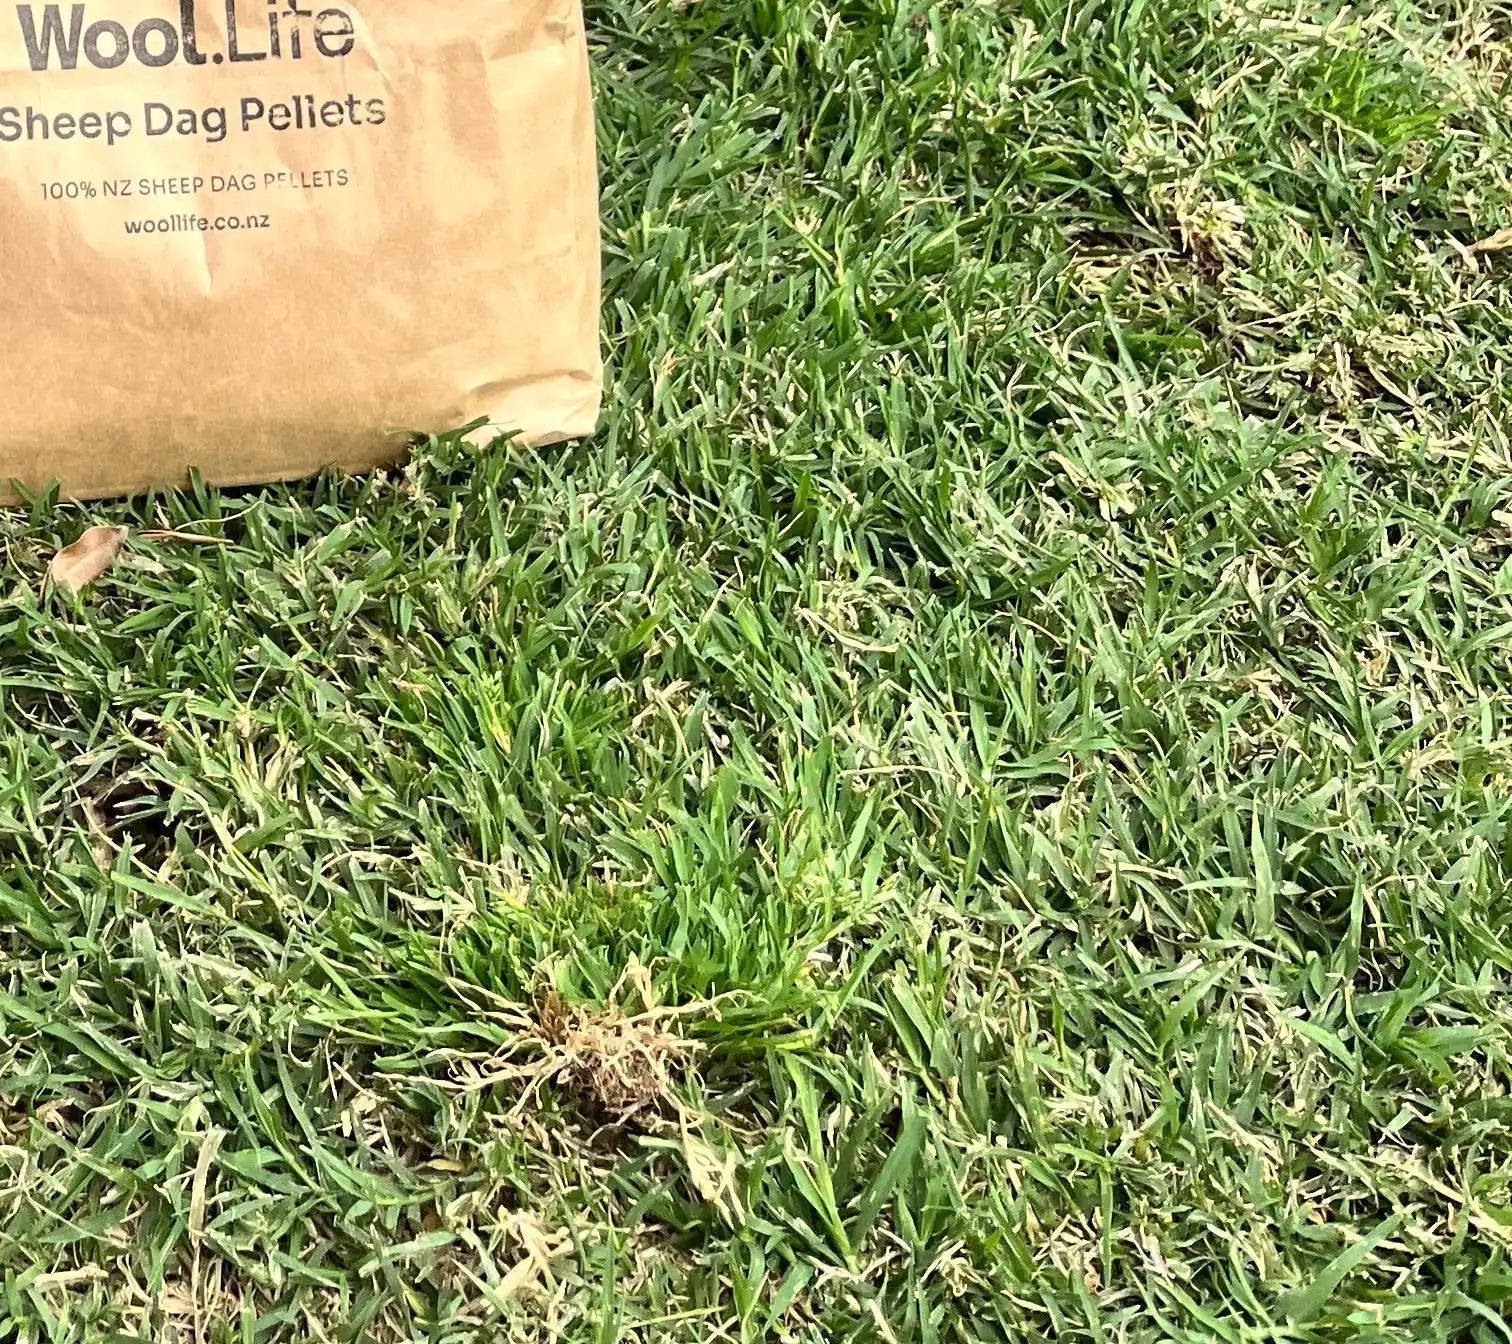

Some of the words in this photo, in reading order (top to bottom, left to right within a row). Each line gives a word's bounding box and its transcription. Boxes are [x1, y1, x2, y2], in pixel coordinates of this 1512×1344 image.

[143, 99, 228, 143] Dag
[240, 92, 387, 132] Pellets
[40, 181, 98, 201] 100%
[103, 178, 133, 197] NZ
[138, 175, 204, 197] SHEEP
[210, 173, 258, 194] DAG
[262, 168, 350, 191] PELLETS
[123, 212, 271, 235] woollife.co.nz
